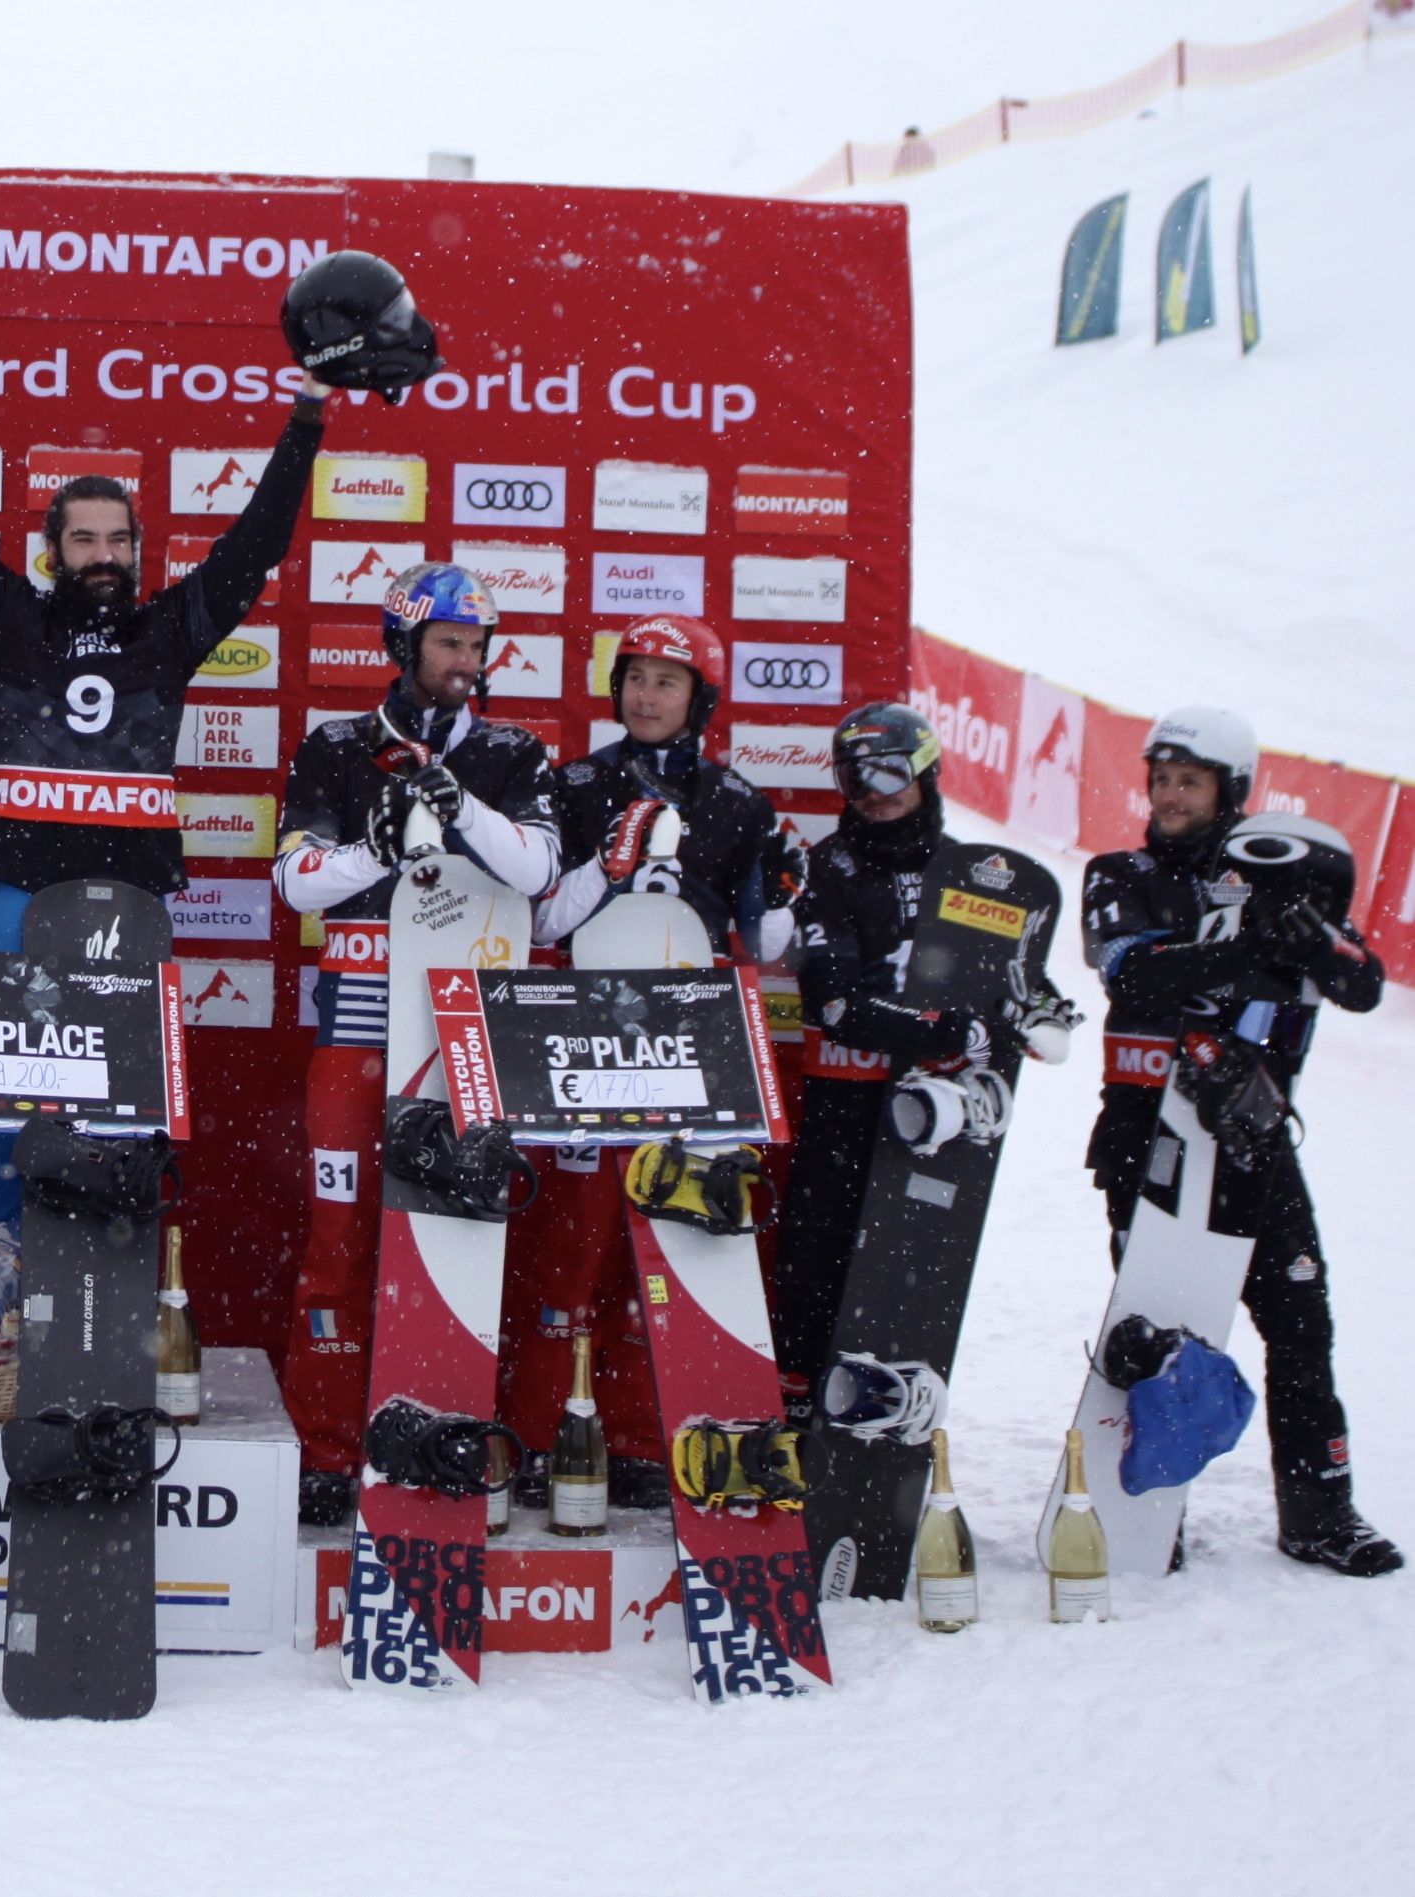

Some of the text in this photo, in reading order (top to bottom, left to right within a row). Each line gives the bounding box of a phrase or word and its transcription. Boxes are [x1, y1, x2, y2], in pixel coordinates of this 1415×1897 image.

[98, 348, 304, 403] Cross
[346, 362, 580, 414] orld
[608, 366, 756, 433] Cup
[331, 477, 405, 496] Lattella
[598, 496, 676, 510] Stand Montafon
[737, 495, 848, 515] MONTAFON
[607, 564, 655, 581] Audi
[606, 585, 685, 602] quattro
[767, 587, 814, 599] Montafon
[630, 621, 690, 647] CHAMONIX
[204, 649, 260, 666] AUCH
[65, 674, 115, 734] 9
[204, 711, 243, 726] VOR
[204, 729, 240, 745] ARL
[203, 747, 254, 763] BERG
[181, 814, 255, 832] Lattella
[172, 890, 222, 904] Audi
[411, 892, 470, 926] Chevalier
[419, 886, 454, 909] Serre
[172, 909, 252, 926] quattro
[427, 910, 465, 932] Vallée
[968, 899, 1019, 925] LOTTO
[513, 984, 576, 995] SNOWBOARD
[167, 984, 185, 1118] WELTCUP-MONTAFON.AT
[545, 1034, 700, 1069] 3RD PLACE
[746, 986, 781, 1121] WELTCUP-MONTAFON.AT
[449, 1041, 474, 1126] WELTCUP
[318, 1161, 355, 1192] 31
[82, 1273, 95, 1352] www.oxess.ch
[354, 1531, 485, 1577] FORCE
[680, 1551, 814, 1589] FORCE
[348, 1561, 484, 1618] PRO
[684, 1580, 817, 1642] PRO
[345, 1606, 483, 1651] TEAM
[689, 1624, 828, 1667] TEAM
[342, 1637, 442, 1688] 165
[693, 1658, 796, 1705] 165
